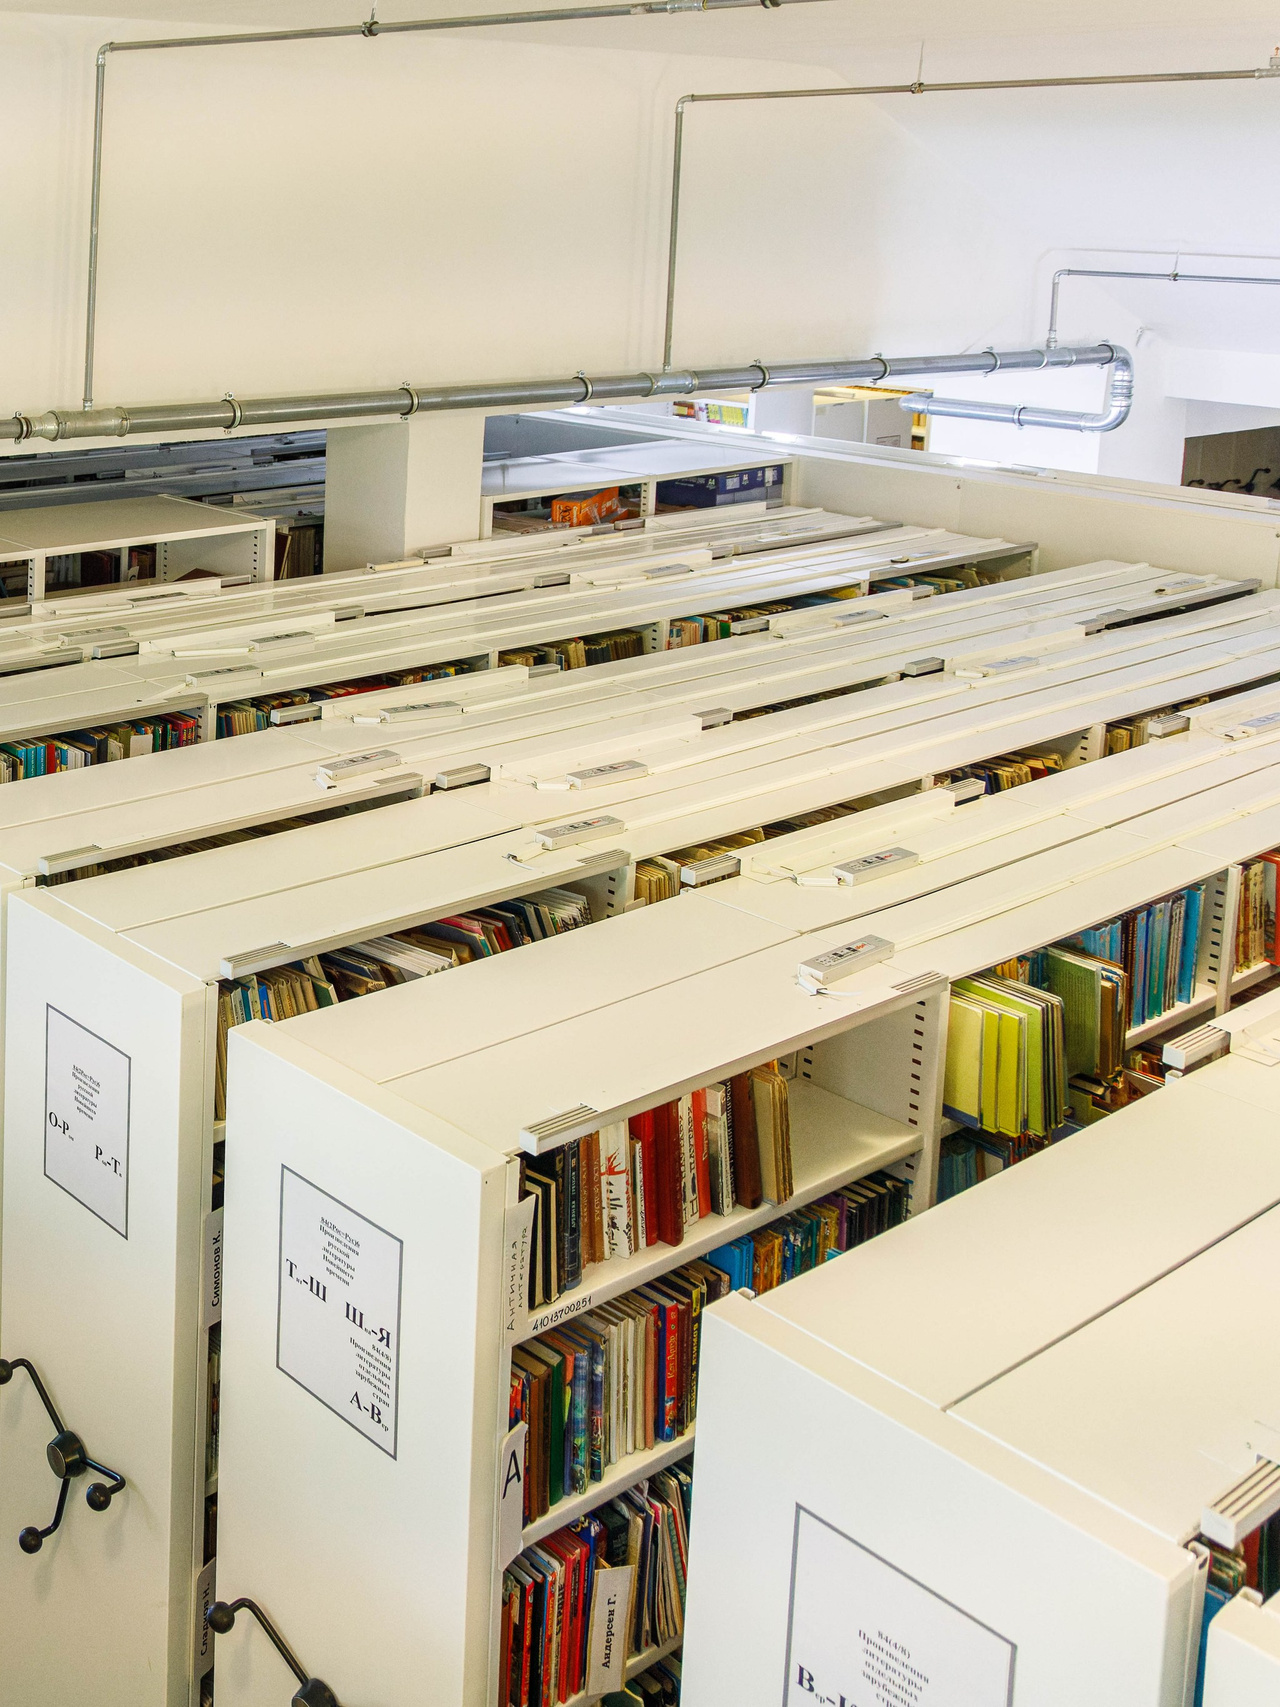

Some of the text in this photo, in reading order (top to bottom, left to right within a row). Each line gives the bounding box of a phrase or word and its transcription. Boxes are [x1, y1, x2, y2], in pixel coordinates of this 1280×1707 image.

[319, 1224, 360, 1257] Произведения
[327, 1241, 350, 1260] русской
[322, 1246, 356, 1273] литературы
[322, 1254, 354, 1281] Новейшего
[325, 1266, 350, 1287] времени
[212, 1247, 221, 1307] Симонов
[507, 1241, 517, 1330] АНТИЧНАЯ
[532, 1296, 592, 1331] 41013700251
[349, 1336, 392, 1372] Произведения
[355, 1352, 391, 1381] литературы
[354, 1369, 391, 1399] зарубежных
[358, 1363, 391, 1390] отдельных
[372, 1391, 390, 1408] стран
[502, 1449, 521, 1500] А
[601, 1594, 617, 1669] Андерсен Г.
[858, 1629, 929, 1684] Произведения
[862, 1647, 923, 1693] литературы
[865, 1660, 918, 1702] отдельных
